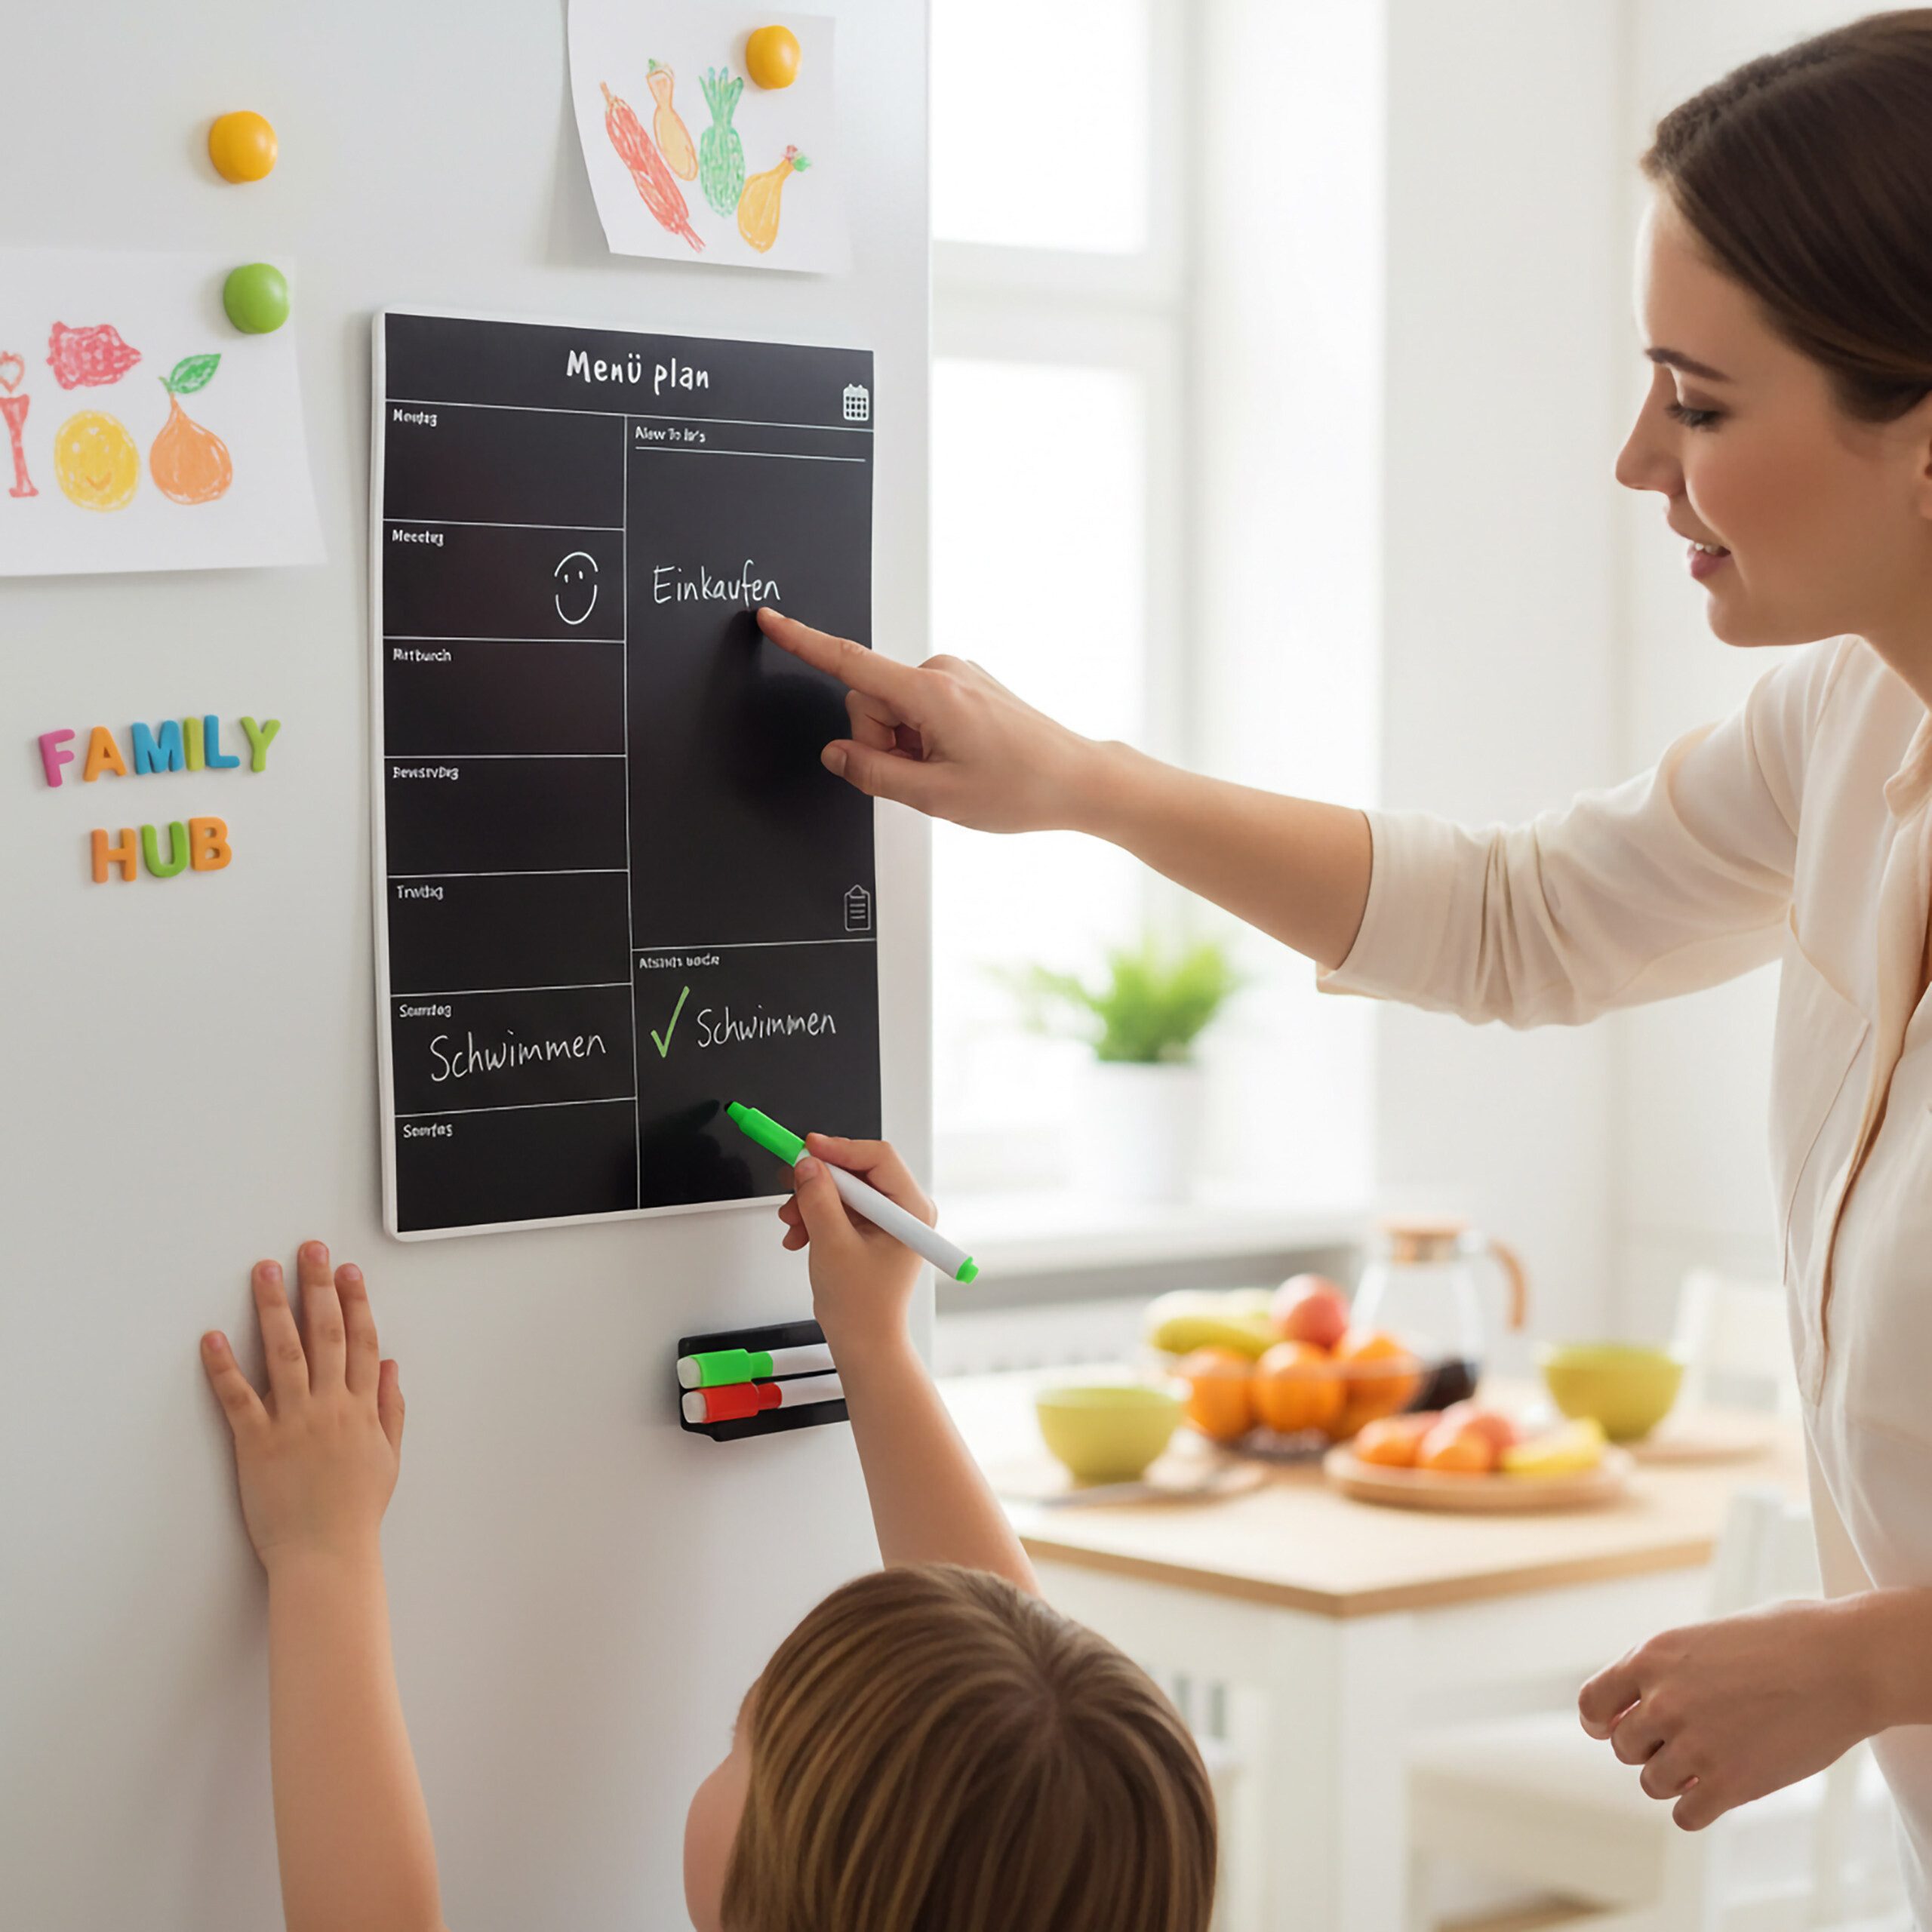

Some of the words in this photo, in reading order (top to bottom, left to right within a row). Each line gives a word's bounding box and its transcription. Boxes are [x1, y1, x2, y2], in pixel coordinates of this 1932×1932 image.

[566, 349, 642, 384] Menü
[654, 358, 709, 394] plan
[653, 559, 782, 611] Einkaufen
[38, 715, 281, 788] FAMILY
[91, 816, 232, 884] HUB
[697, 1005, 836, 1048] Schwimmen
[429, 1029, 607, 1082] Schwimmen
